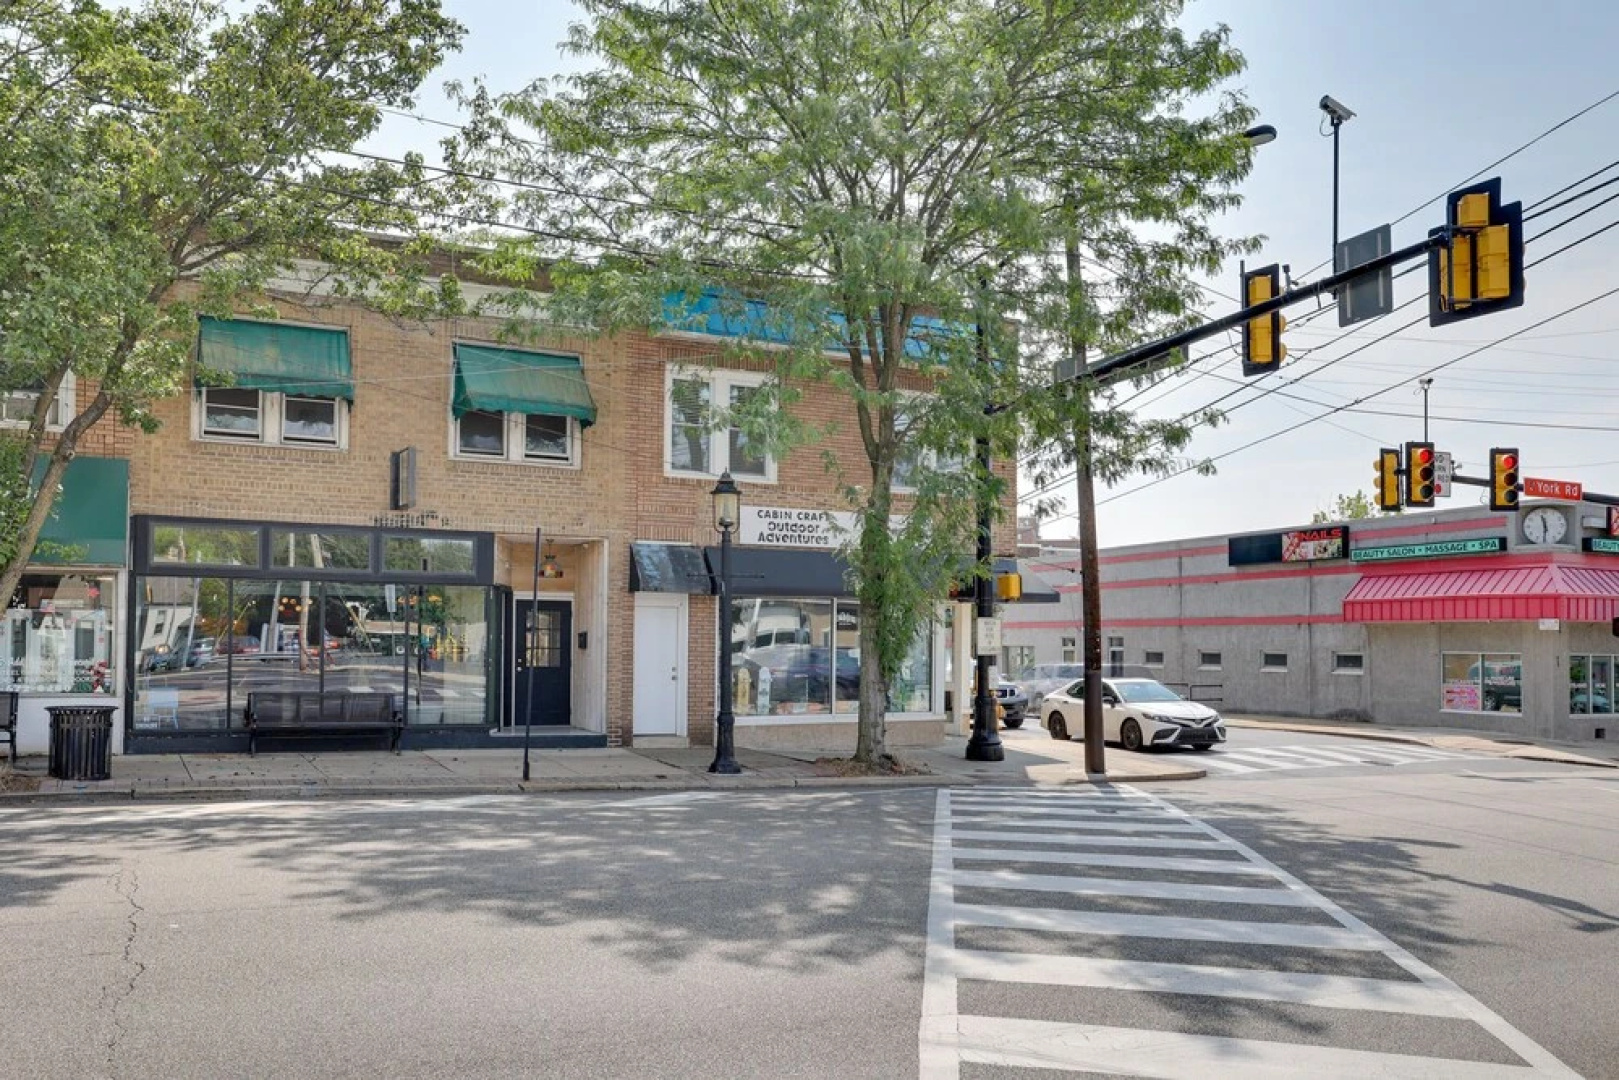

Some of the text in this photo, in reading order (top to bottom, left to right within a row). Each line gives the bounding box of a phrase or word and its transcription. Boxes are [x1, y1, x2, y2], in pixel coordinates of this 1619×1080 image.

[1536, 480, 1578, 497] York Rd
[757, 509, 792, 520] CABIN
[767, 521, 820, 534] Outdoor
[757, 531, 829, 545] Adventures
[1300, 528, 1342, 541] NAILS
[1353, 540, 1497, 560] BEAUTY SALON MASSAGE SPA
[1593, 540, 1619, 550] BEAUT
